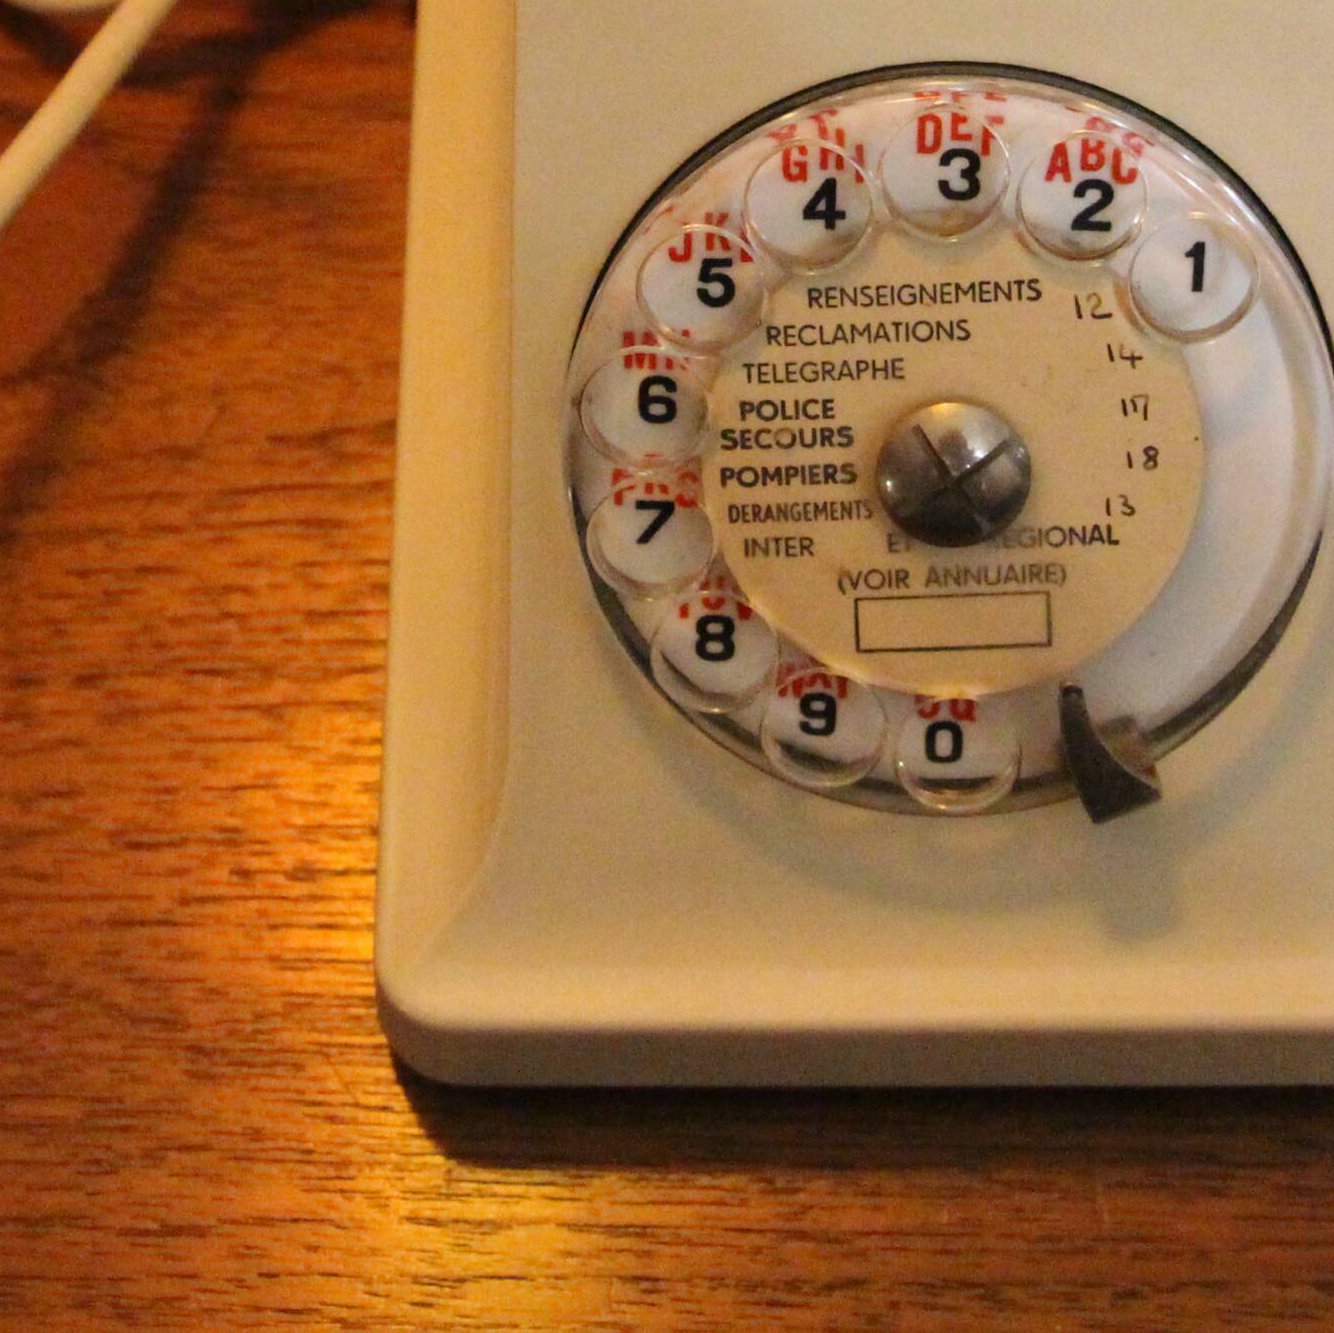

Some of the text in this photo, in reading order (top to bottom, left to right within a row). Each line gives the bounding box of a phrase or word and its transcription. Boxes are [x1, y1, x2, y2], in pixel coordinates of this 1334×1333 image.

[938, 147, 981, 201] 3
[1044, 136, 1138, 185] ABC
[803, 177, 846, 230] 4
[1071, 178, 1114, 232] 2
[1185, 241, 1205, 292] 1
[696, 258, 736, 308] 5
[807, 279, 1042, 309] RENSEIGNEMENTS
[1074, 292, 1113, 320] 12
[766, 319, 971, 347] RECLAMATIONS
[741, 358, 906, 384] TELEGRAPHE
[1107, 343, 1143, 369] 14
[637, 375, 677, 424] 6
[739, 399, 836, 422] POLICE
[720, 426, 854, 451] SECOURS
[1127, 445, 1159, 471] 18
[720, 463, 858, 488] POMPIERS
[728, 498, 873, 524] DERANGEMENTS
[1105, 494, 1136, 517] 13
[635, 500, 676, 544] 7
[744, 536, 815, 558] INTER
[837, 563, 1066, 594] (VOIR ANNUAIRE)
[695, 615, 736, 662] 8
[799, 692, 837, 737] 9
